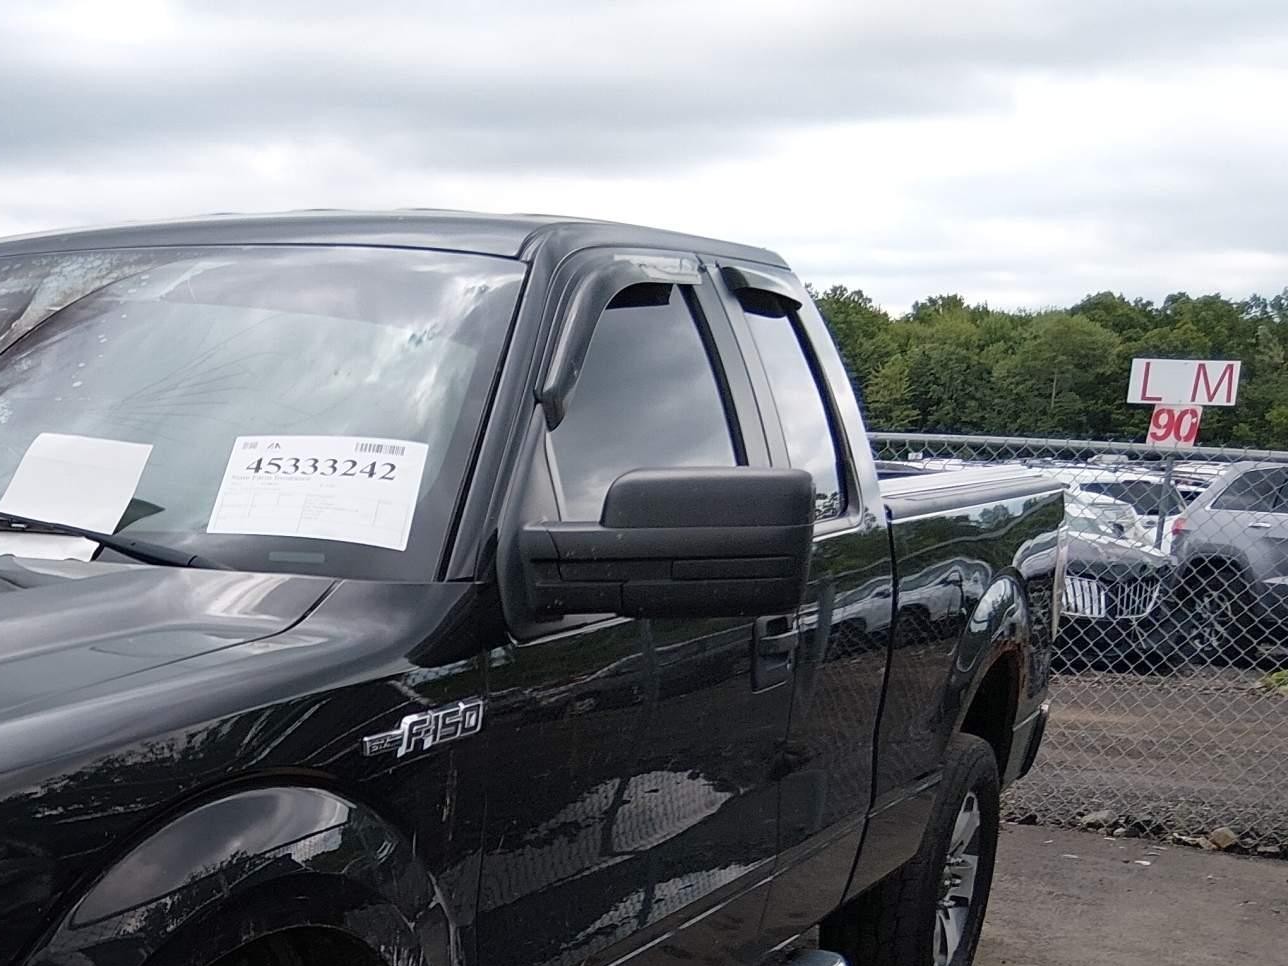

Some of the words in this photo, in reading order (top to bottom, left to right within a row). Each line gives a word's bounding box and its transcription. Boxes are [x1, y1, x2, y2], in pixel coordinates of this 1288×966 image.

[1141, 361, 1162, 402] L
[1190, 363, 1235, 403] M
[1149, 407, 1199, 443] 90
[246, 457, 397, 481] 45333242
